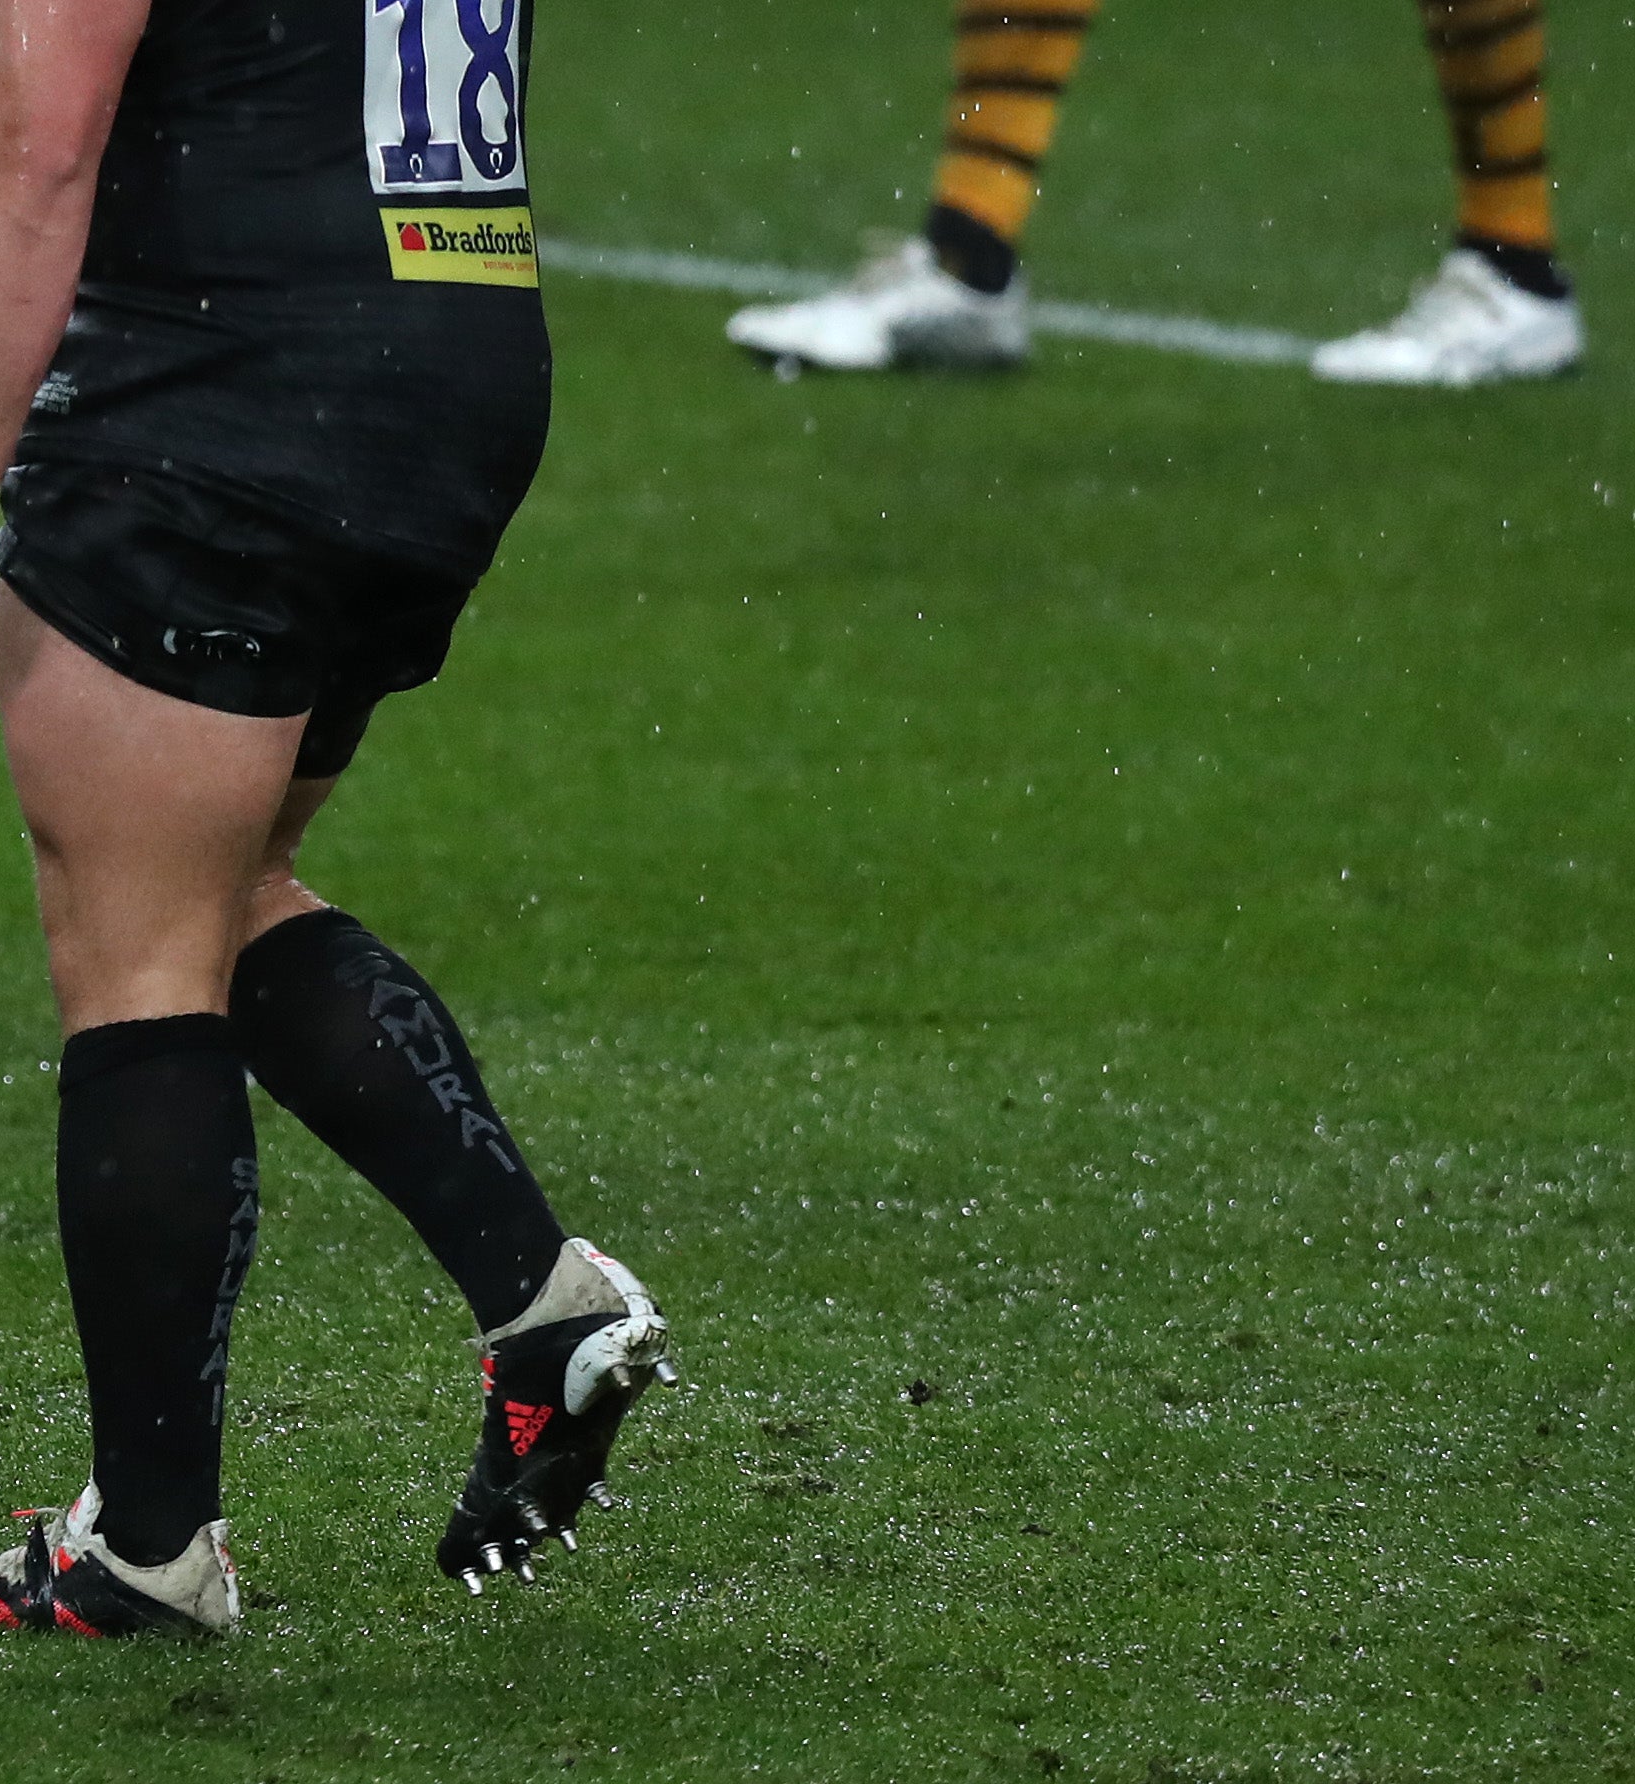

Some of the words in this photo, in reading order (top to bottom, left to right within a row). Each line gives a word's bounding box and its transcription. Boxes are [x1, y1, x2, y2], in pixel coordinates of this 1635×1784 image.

[424, 221, 534, 255] Bradfords
[334, 950, 517, 1174] SAMURAI
[199, 1157, 259, 1426] SAMURAI
